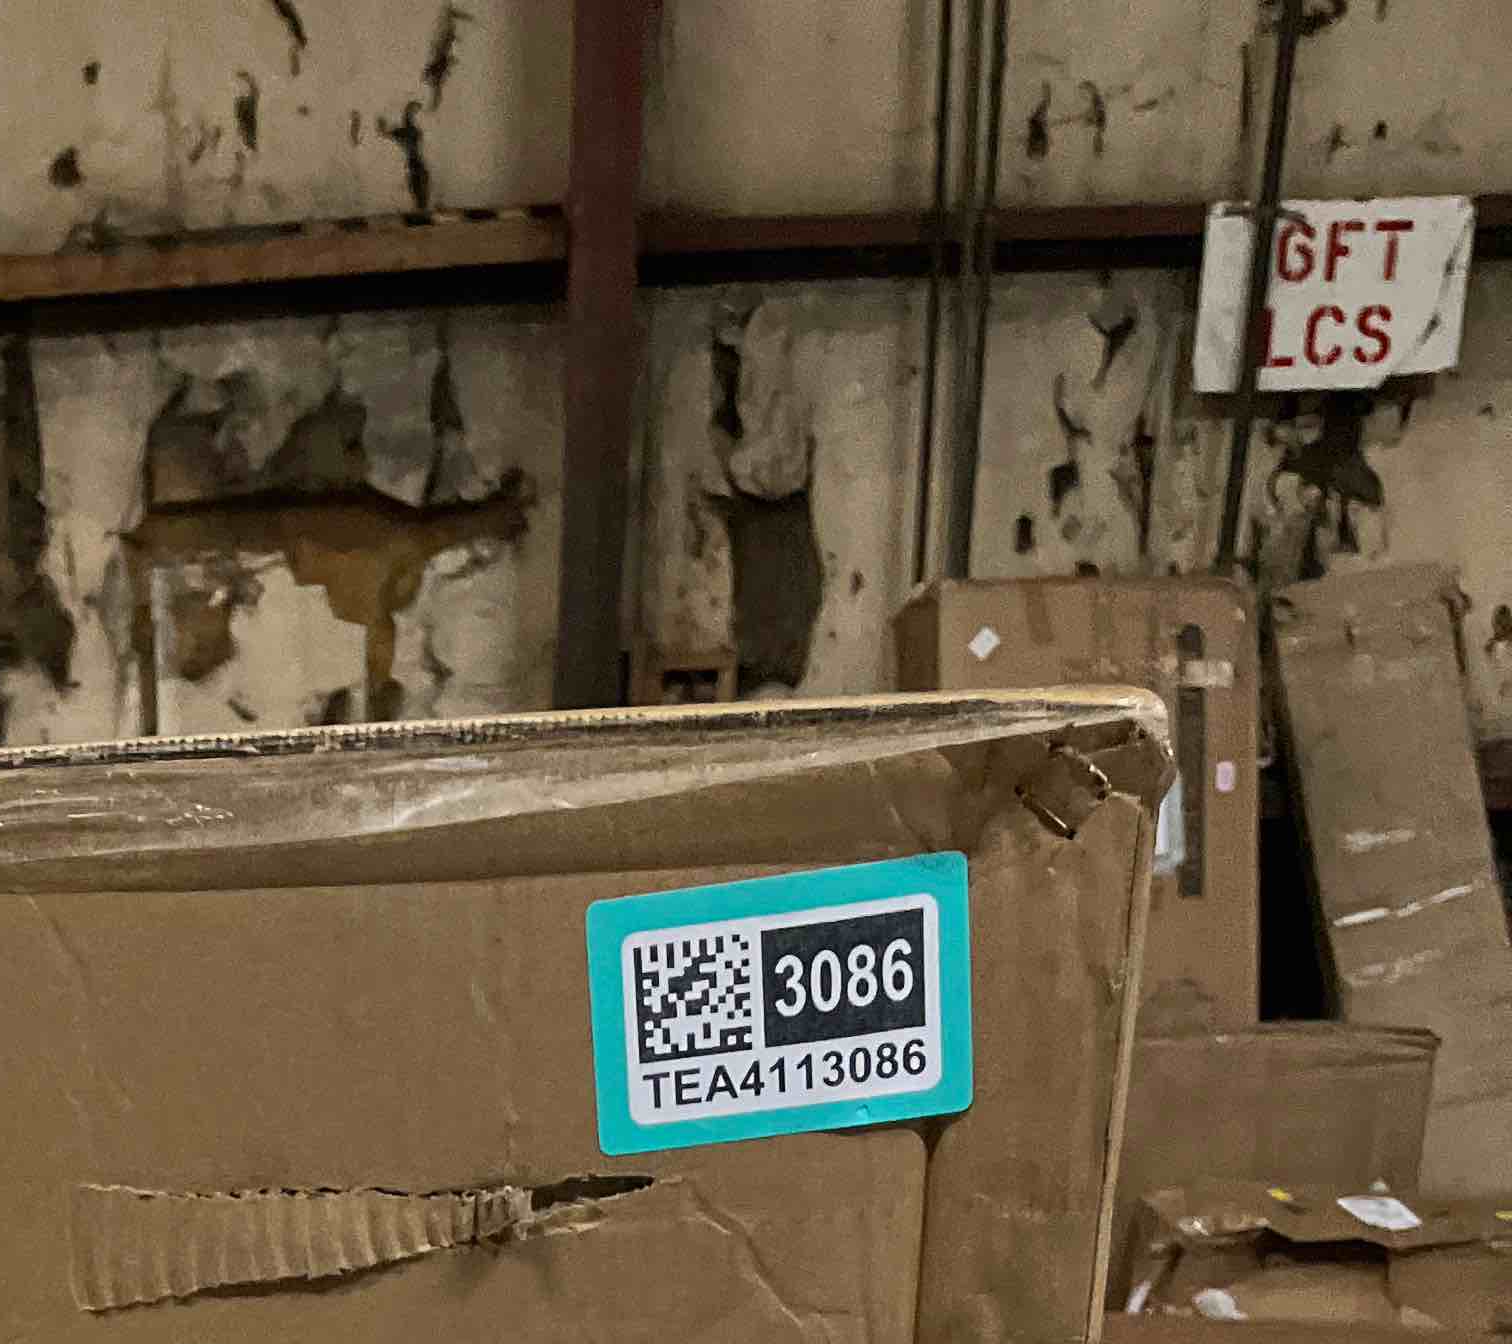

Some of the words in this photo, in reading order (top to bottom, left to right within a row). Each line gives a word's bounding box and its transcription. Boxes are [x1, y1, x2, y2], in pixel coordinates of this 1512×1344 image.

[1260, 304, 1392, 367] LCS
[773, 937, 915, 1018] 3086
[642, 1038, 928, 1109] TEA4113086
